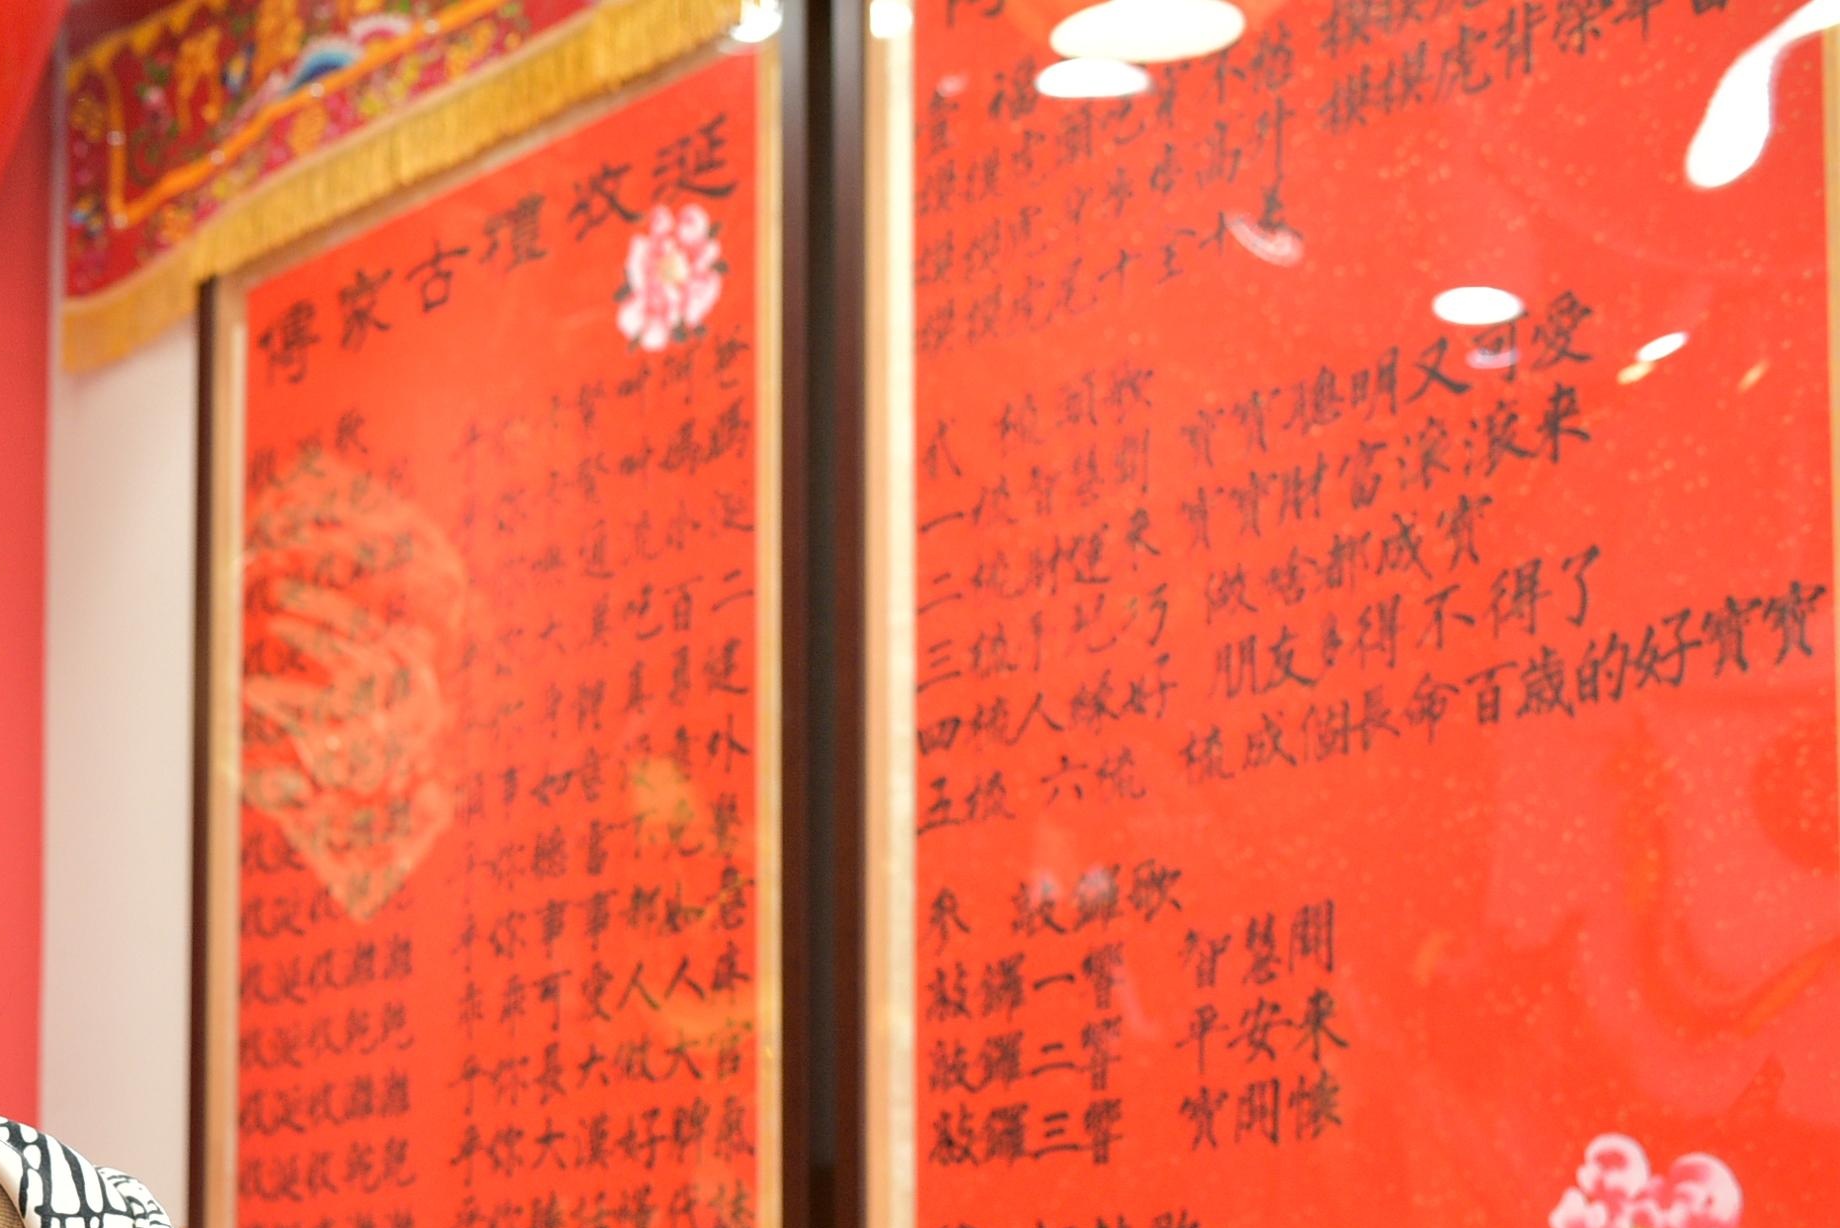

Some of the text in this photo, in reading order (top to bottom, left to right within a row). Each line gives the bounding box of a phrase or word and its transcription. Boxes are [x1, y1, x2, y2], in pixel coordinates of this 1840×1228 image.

[1208, 545, 1601, 700] 朋友多得不得了
[1178, 899, 1336, 990] 智慧開
[1175, 990, 1348, 1072] 平安來
